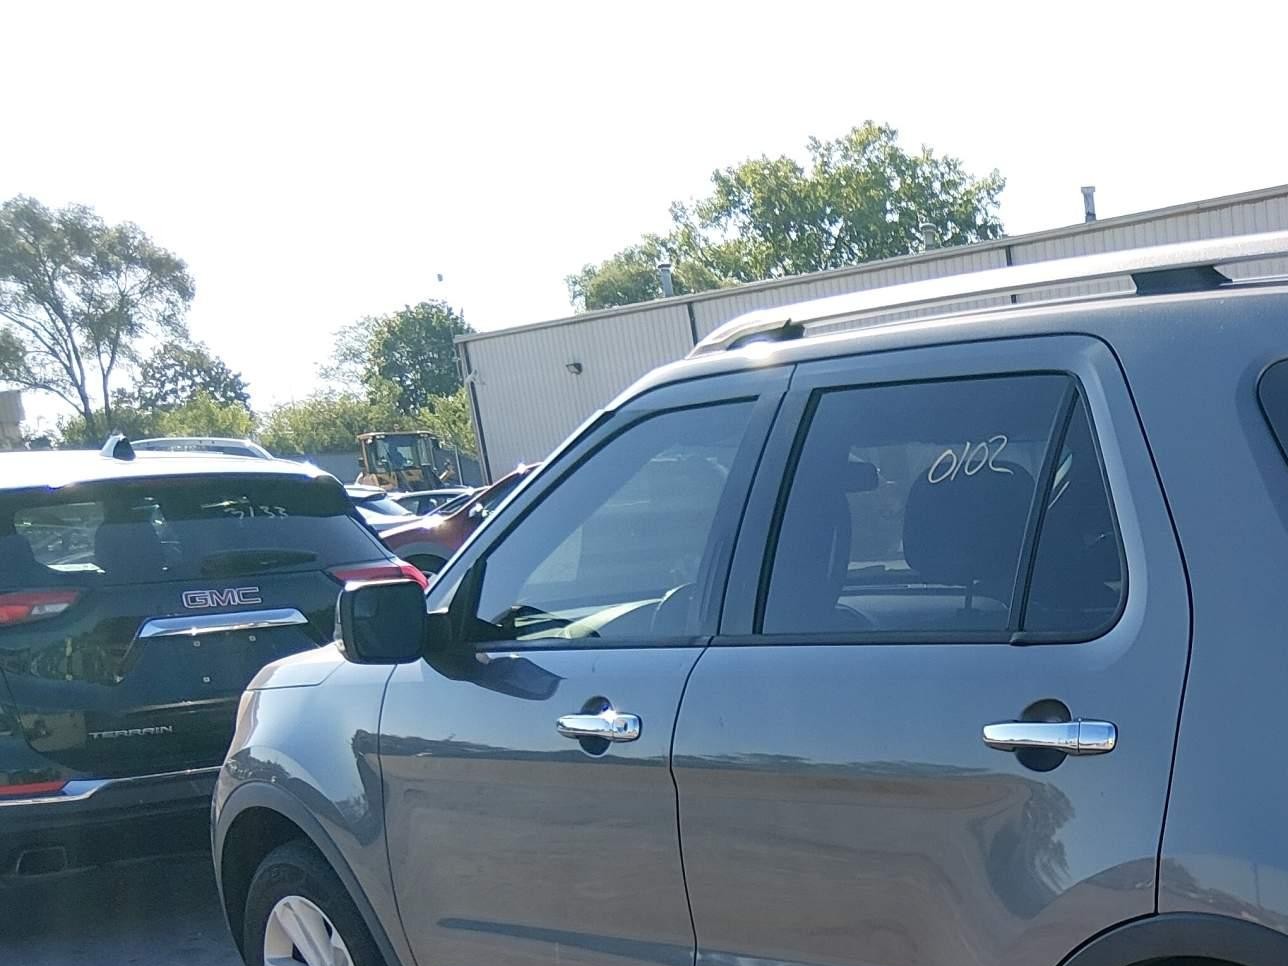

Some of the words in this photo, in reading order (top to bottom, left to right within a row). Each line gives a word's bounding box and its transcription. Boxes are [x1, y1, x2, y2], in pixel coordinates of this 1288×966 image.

[928, 434, 1014, 484] 0102
[182, 586, 262, 609] GMC
[87, 725, 173, 739] TERRAIN
